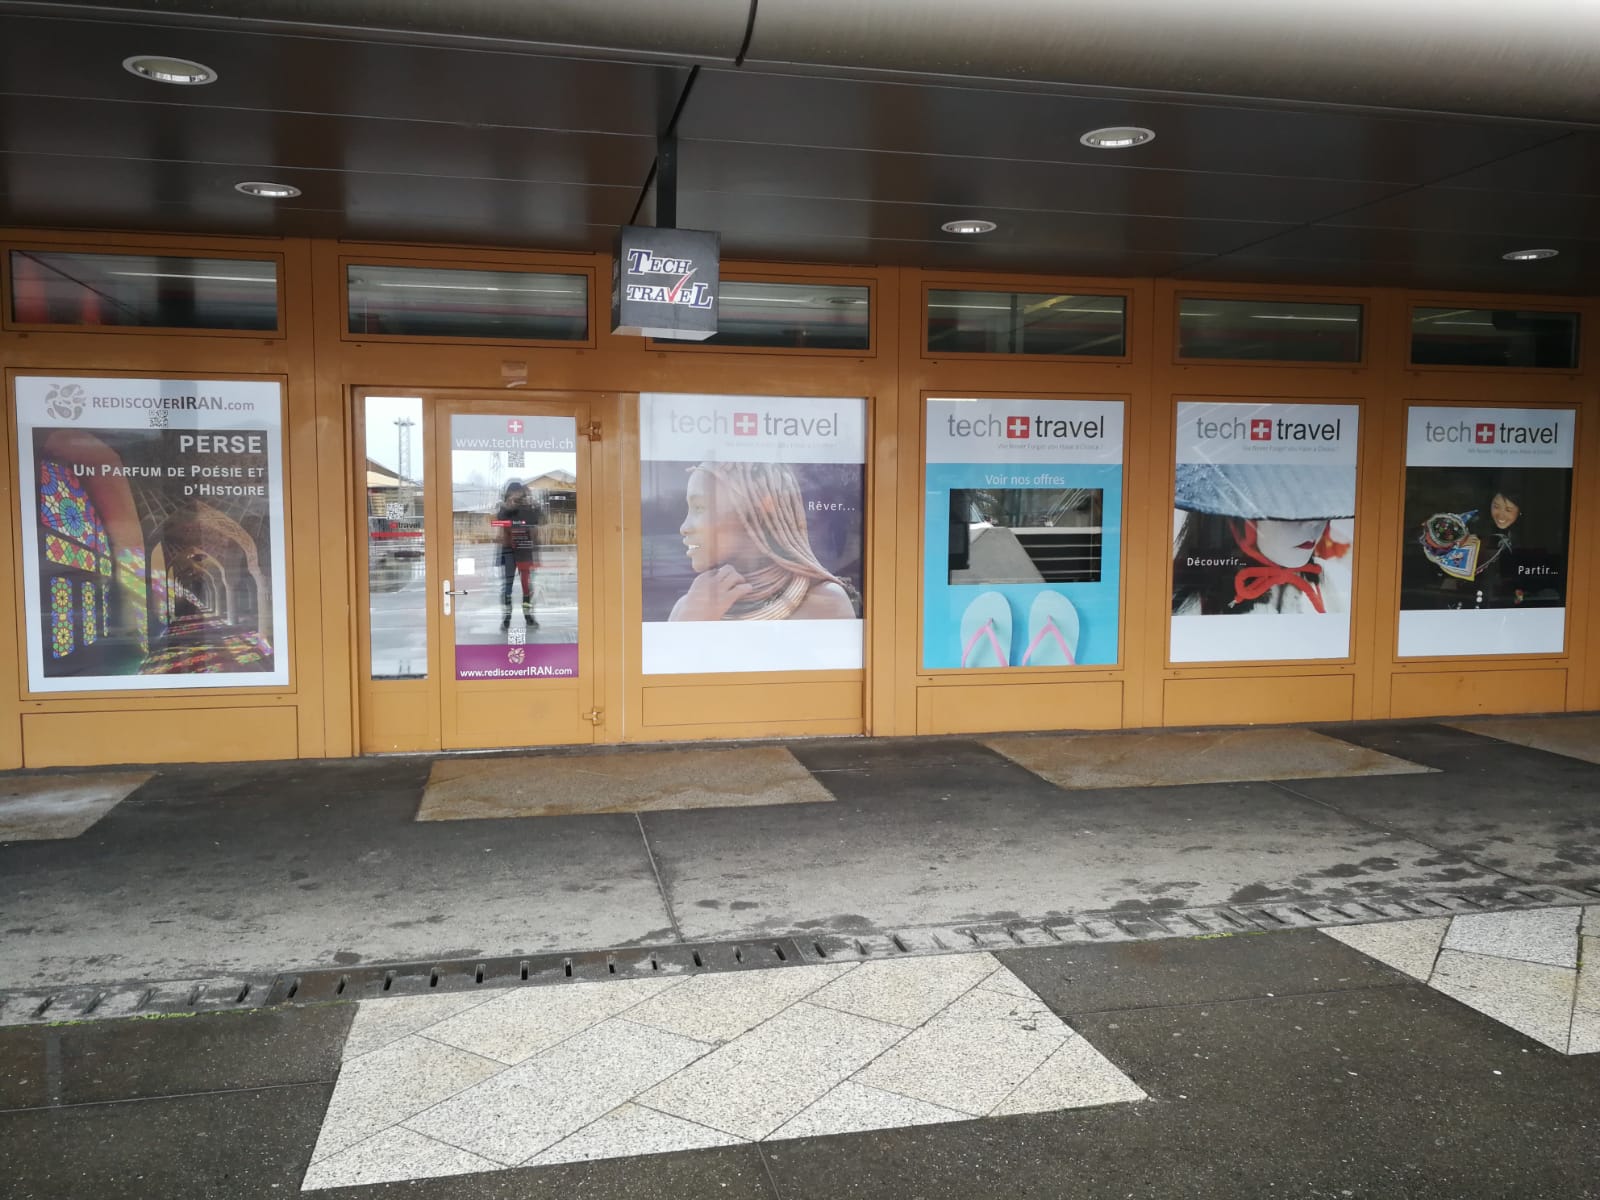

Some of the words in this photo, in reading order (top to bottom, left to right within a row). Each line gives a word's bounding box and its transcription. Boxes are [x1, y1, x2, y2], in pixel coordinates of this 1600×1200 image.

[627, 249, 691, 274] TECH
[627, 267, 713, 309] TRAVEL
[671, 410, 728, 433] tech
[764, 413, 838, 436] travel
[948, 414, 1001, 437] tech
[1036, 416, 1104, 438] travel
[1196, 417, 1246, 439] tech
[1277, 419, 1340, 440] travel
[1426, 421, 1471, 442] tech
[1500, 423, 1558, 443] travel
[180, 435, 262, 454] PERSE
[456, 436, 573, 450] www.techtravel.ch
[102, 464, 161, 477] PARFUM
[986, 474, 1009, 485] Voir
[1011, 476, 1030, 485] nos
[1034, 474, 1064, 485] offres
[808, 501, 855, 511] Rêver...
[460, 666, 572, 677] www.rediscoverIRAN.com
